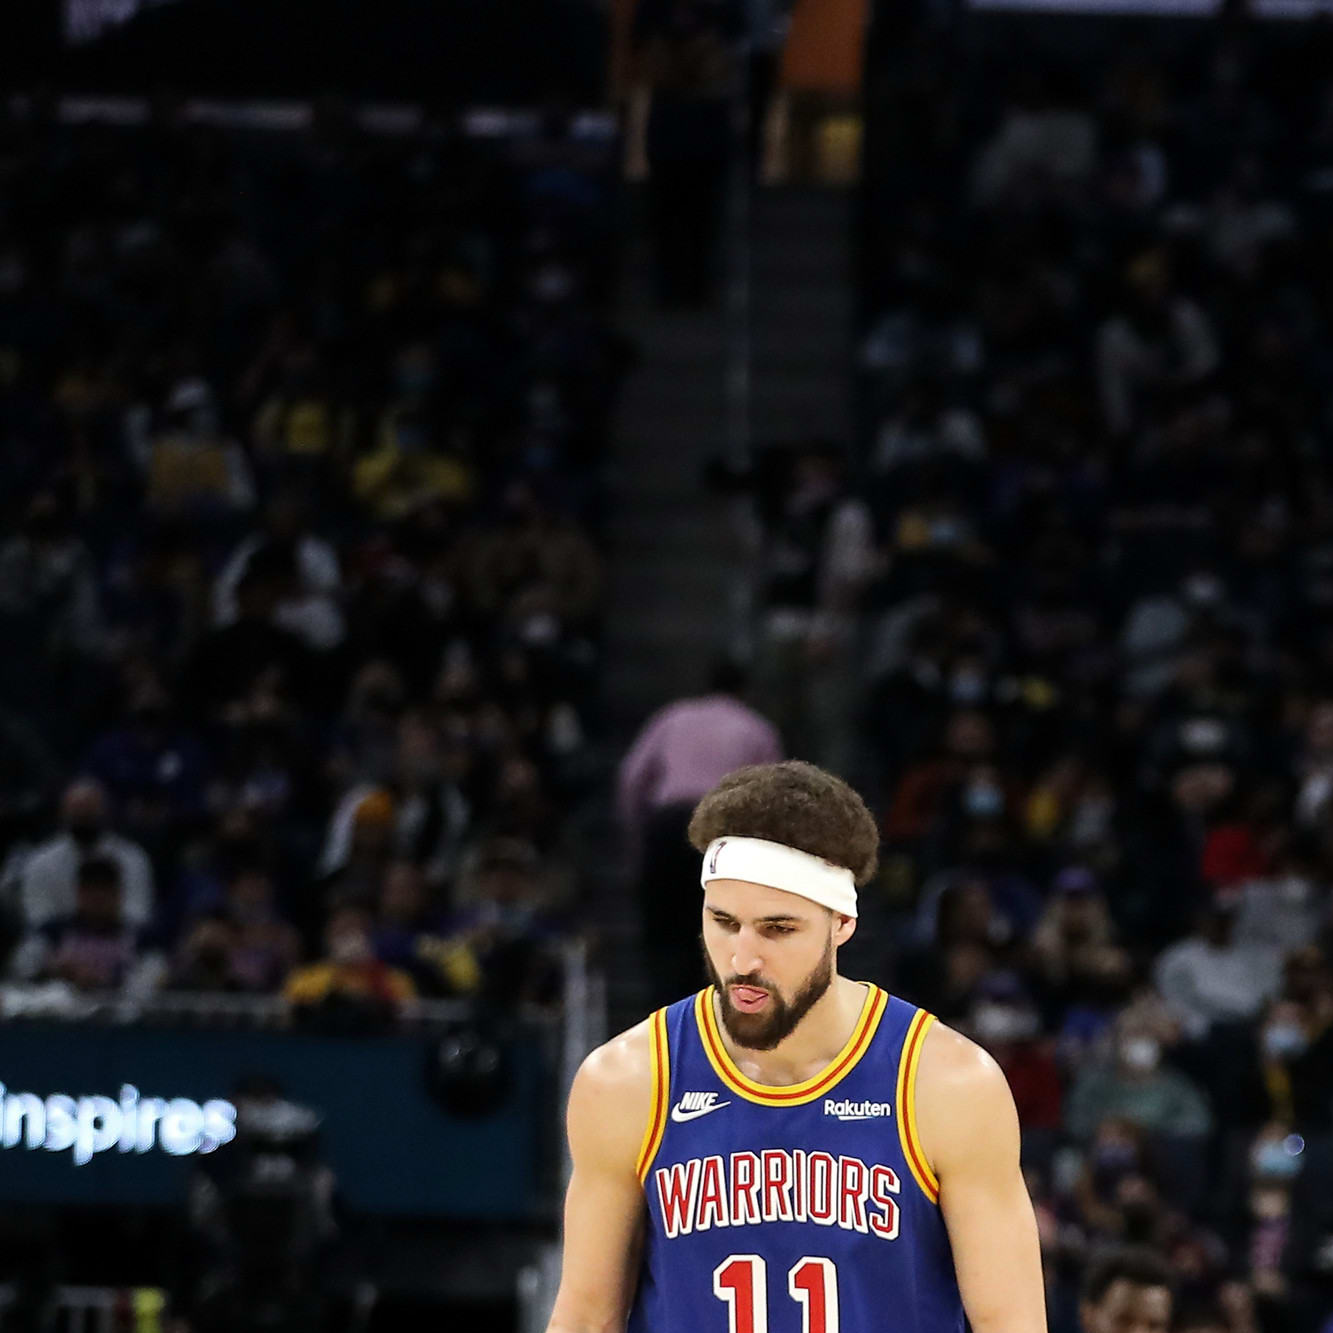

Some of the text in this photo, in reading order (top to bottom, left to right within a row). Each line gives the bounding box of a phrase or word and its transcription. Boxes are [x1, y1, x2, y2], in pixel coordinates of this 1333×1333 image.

[680, 1091, 719, 1111] NIKE
[824, 1099, 891, 1118] Rakuten
[655, 1148, 901, 1241] WARRIORS
